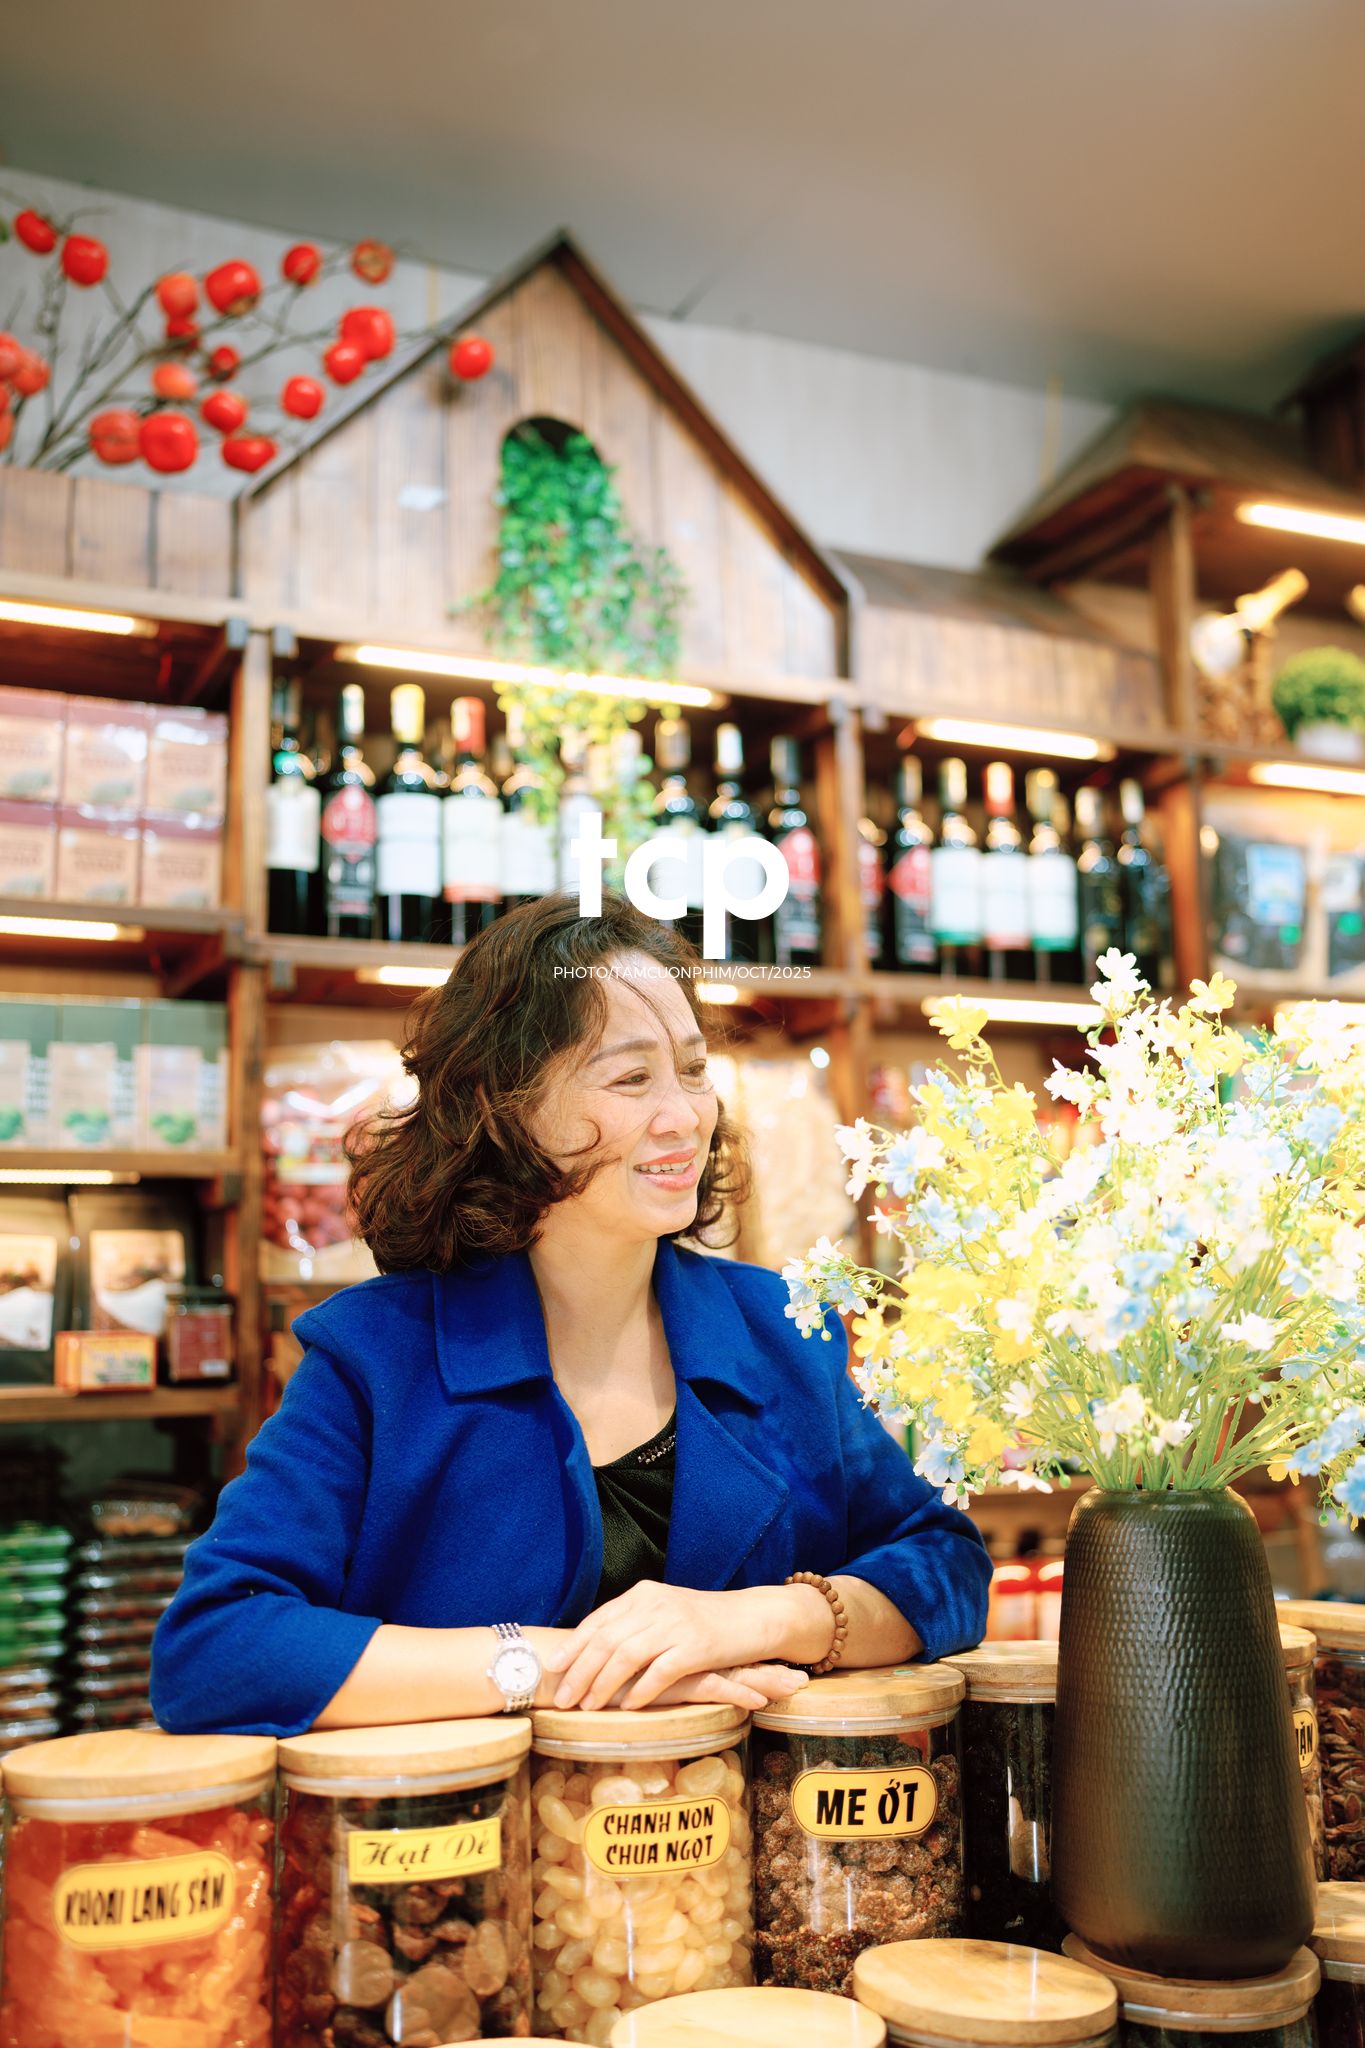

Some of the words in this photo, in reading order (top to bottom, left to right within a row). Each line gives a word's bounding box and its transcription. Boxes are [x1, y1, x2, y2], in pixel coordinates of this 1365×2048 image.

[816, 1788, 867, 1826] ME
[877, 1778, 919, 1825] ỚT
[603, 1811, 671, 1835] CHANH
[678, 1804, 714, 1831] NON
[362, 1841, 433, 1872] Hạt
[605, 1843, 659, 1865] CHUA
[666, 1834, 713, 1863] NGỌT
[65, 1887, 125, 1926] KHOAI
[132, 1882, 181, 1923] LANG
